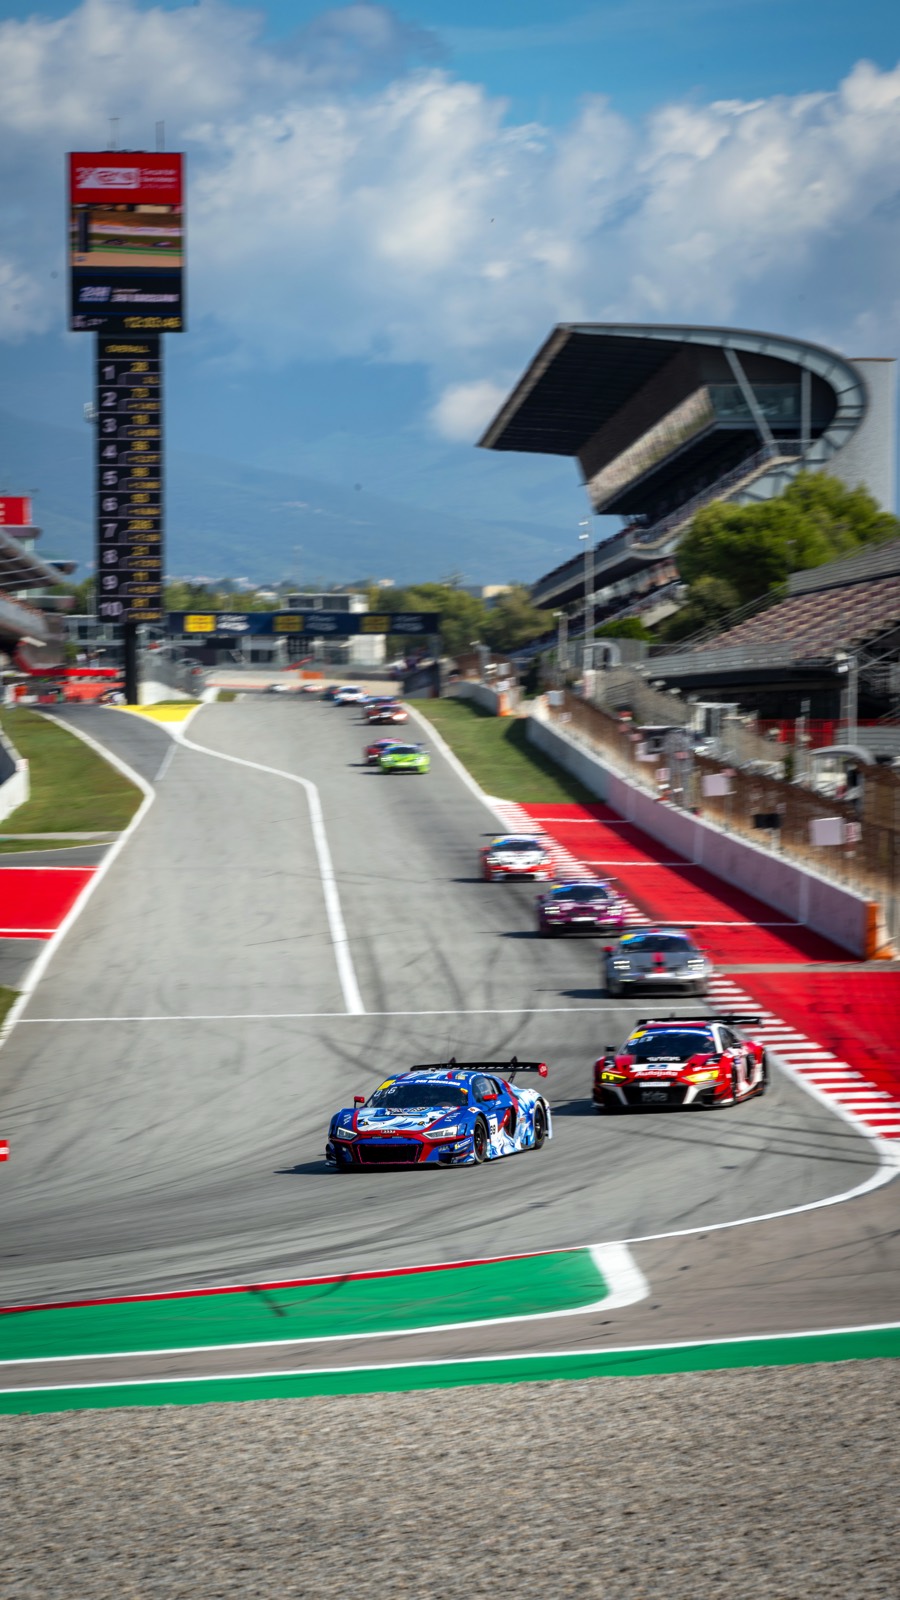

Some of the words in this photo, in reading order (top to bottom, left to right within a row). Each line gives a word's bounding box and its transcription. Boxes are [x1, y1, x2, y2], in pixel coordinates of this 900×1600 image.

[101, 365, 116, 380] 1
[101, 391, 118, 407] 2
[102, 417, 118, 433] 3
[101, 444, 119, 459] 4
[102, 470, 118, 486] 5
[102, 497, 118, 512] 6
[102, 523, 118, 538] 7
[102, 549, 118, 564] 8
[102, 575, 118, 590] 9
[99, 601, 124, 617] 10
